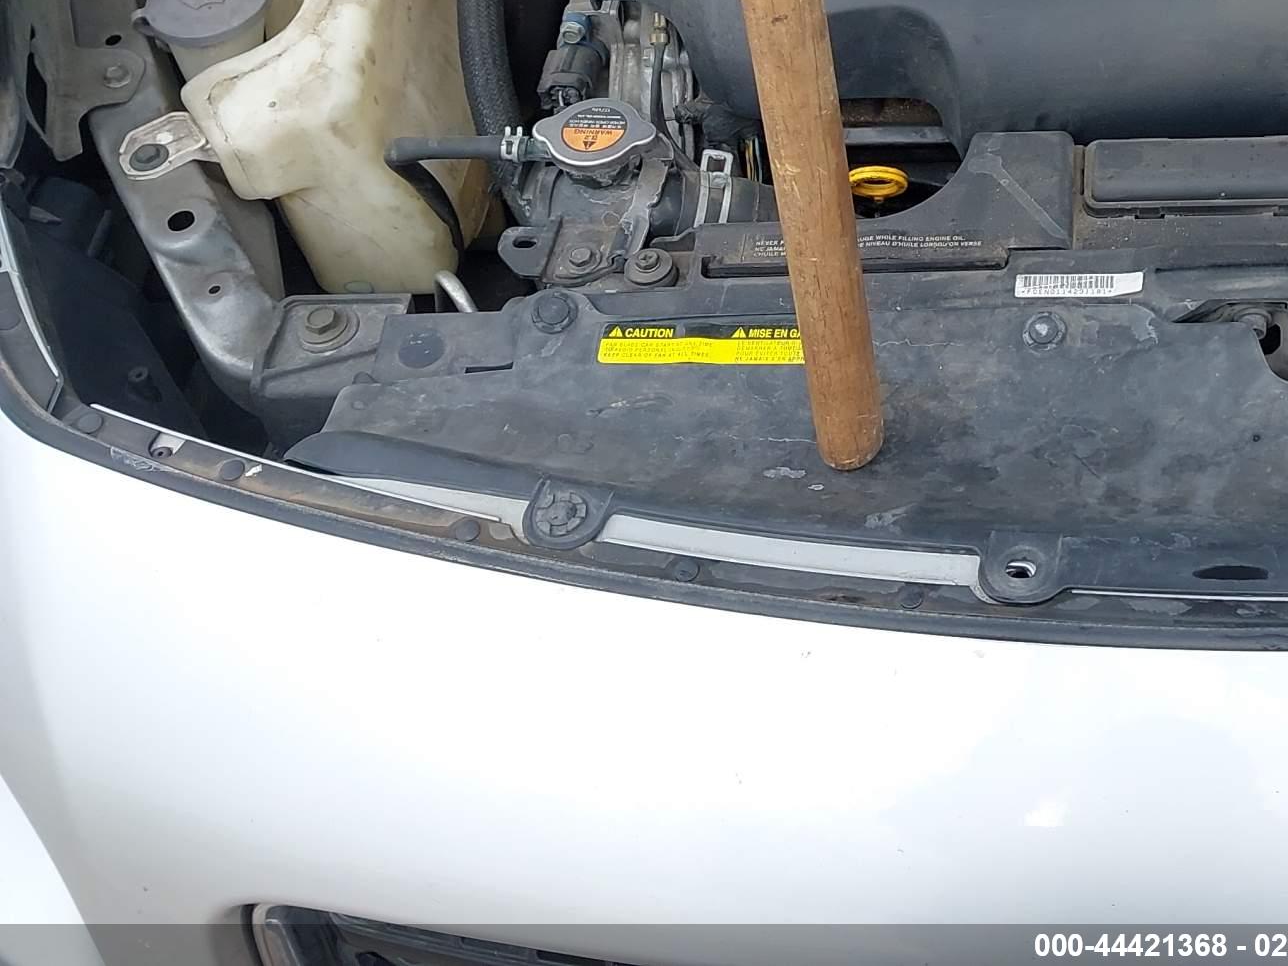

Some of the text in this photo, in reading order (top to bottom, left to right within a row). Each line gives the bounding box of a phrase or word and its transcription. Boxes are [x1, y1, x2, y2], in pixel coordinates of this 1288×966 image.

[624, 327, 675, 338] CAUTION
[748, 328, 773, 339] MISE
[773, 328, 789, 339] EN
